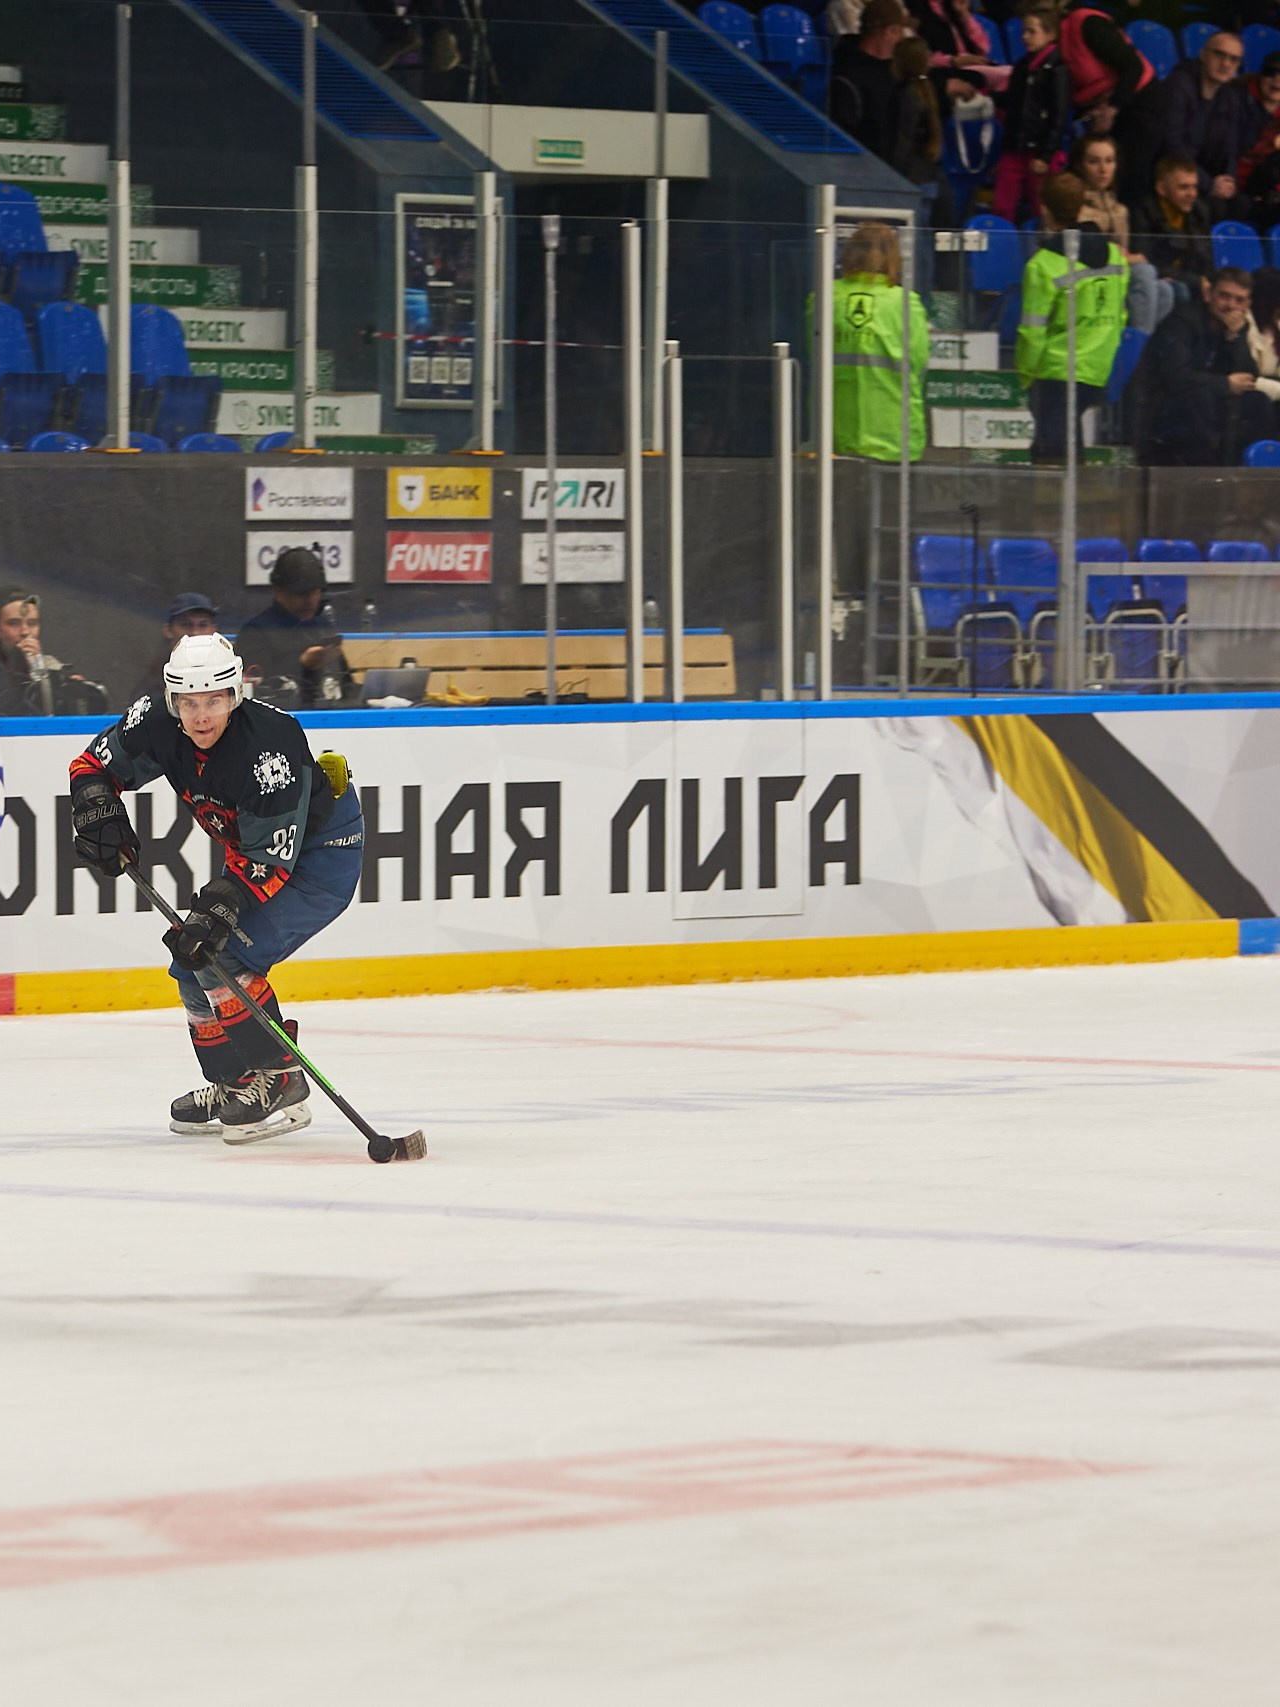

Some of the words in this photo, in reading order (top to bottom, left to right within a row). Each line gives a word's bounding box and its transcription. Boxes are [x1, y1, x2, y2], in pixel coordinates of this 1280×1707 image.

[72, 238, 157, 260] SYNEETIC
[183, 320, 245, 343] ERGETIC
[221, 362, 288, 380] КРАСОТЫ
[257, 405, 341, 427] SYNEETIC
[268, 491, 347, 508] Ростелеком
[429, 485, 480, 501] БАНК
[388, 544, 489, 572] FONBET
[76, 803, 127, 828] BAUE
[265, 824, 298, 861] 93
[610, 773, 861, 893] ЛИГА
